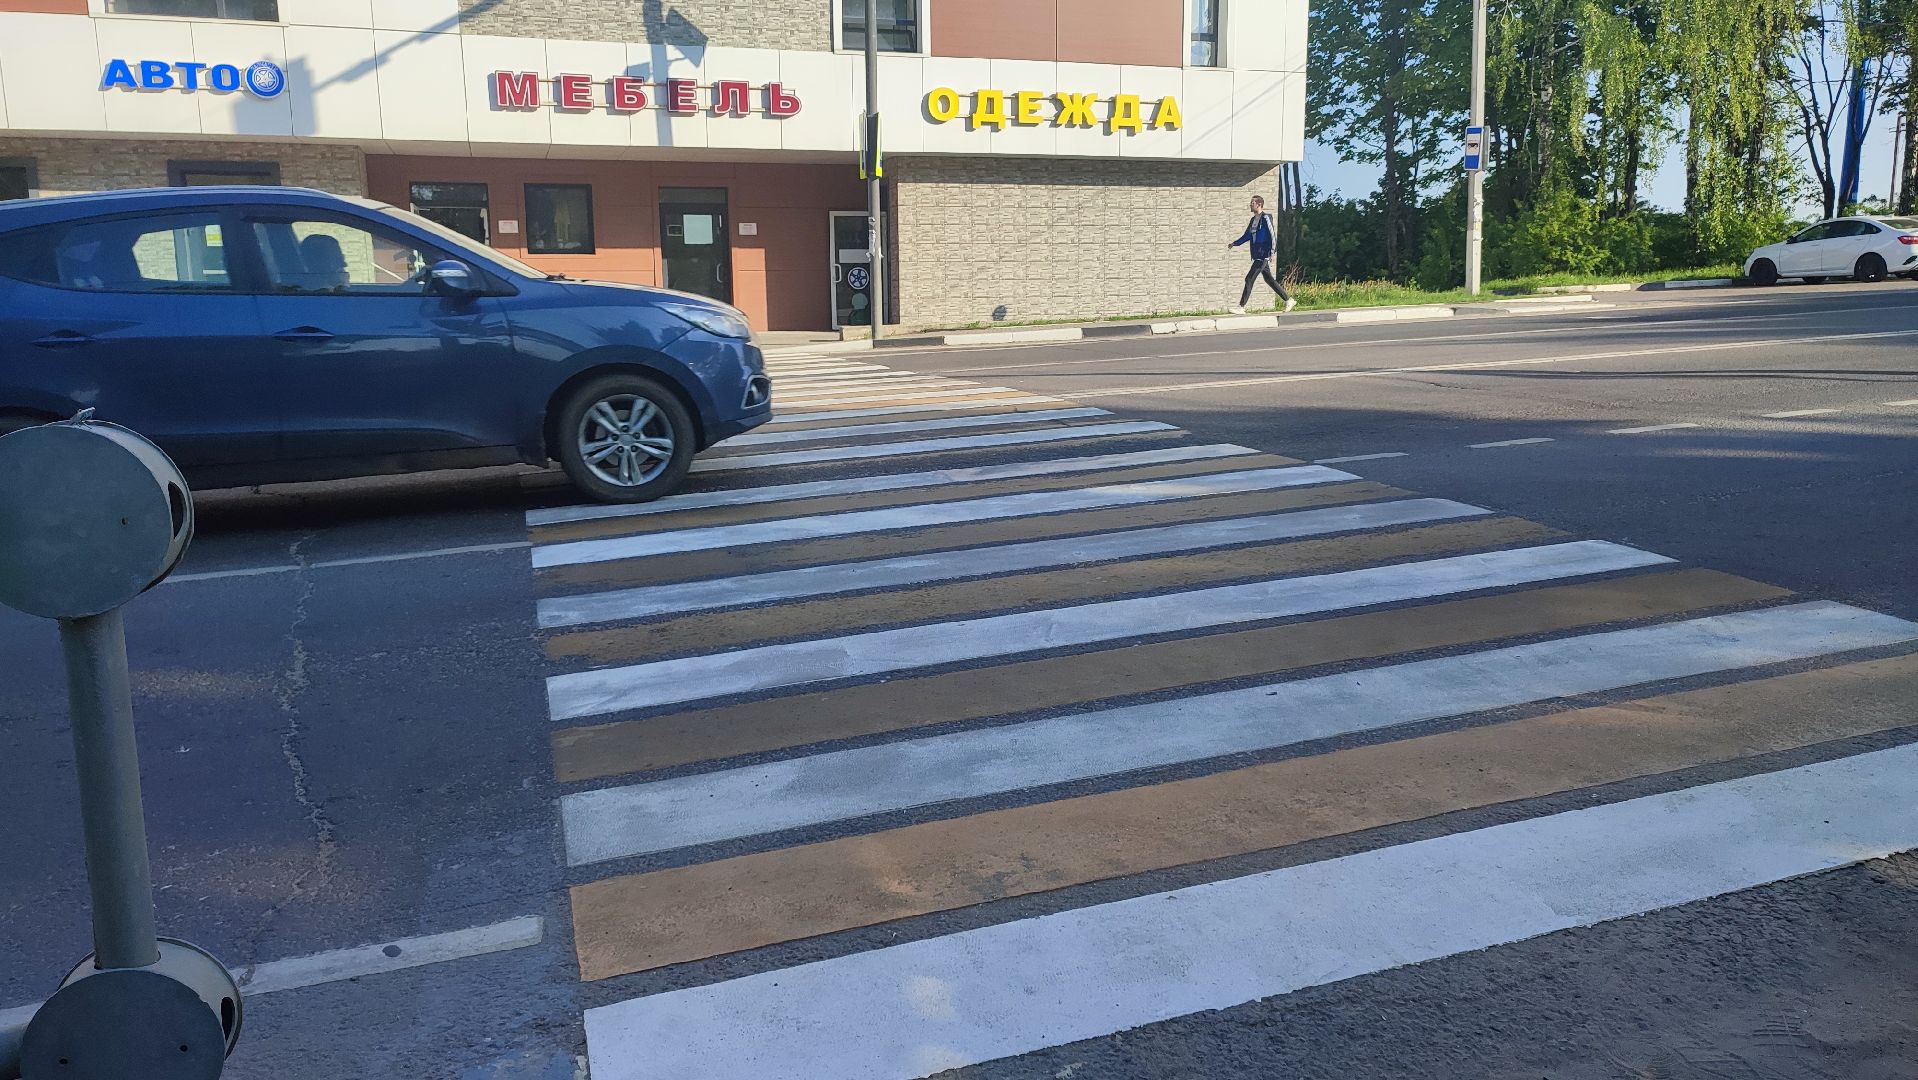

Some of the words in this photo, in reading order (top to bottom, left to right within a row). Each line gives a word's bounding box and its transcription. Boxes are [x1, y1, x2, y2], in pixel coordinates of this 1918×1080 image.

[103, 59, 241, 92] АВТО
[495, 70, 802, 116] МЕБЕЛЬ
[928, 87, 1182, 133] ОДЕЖДА
